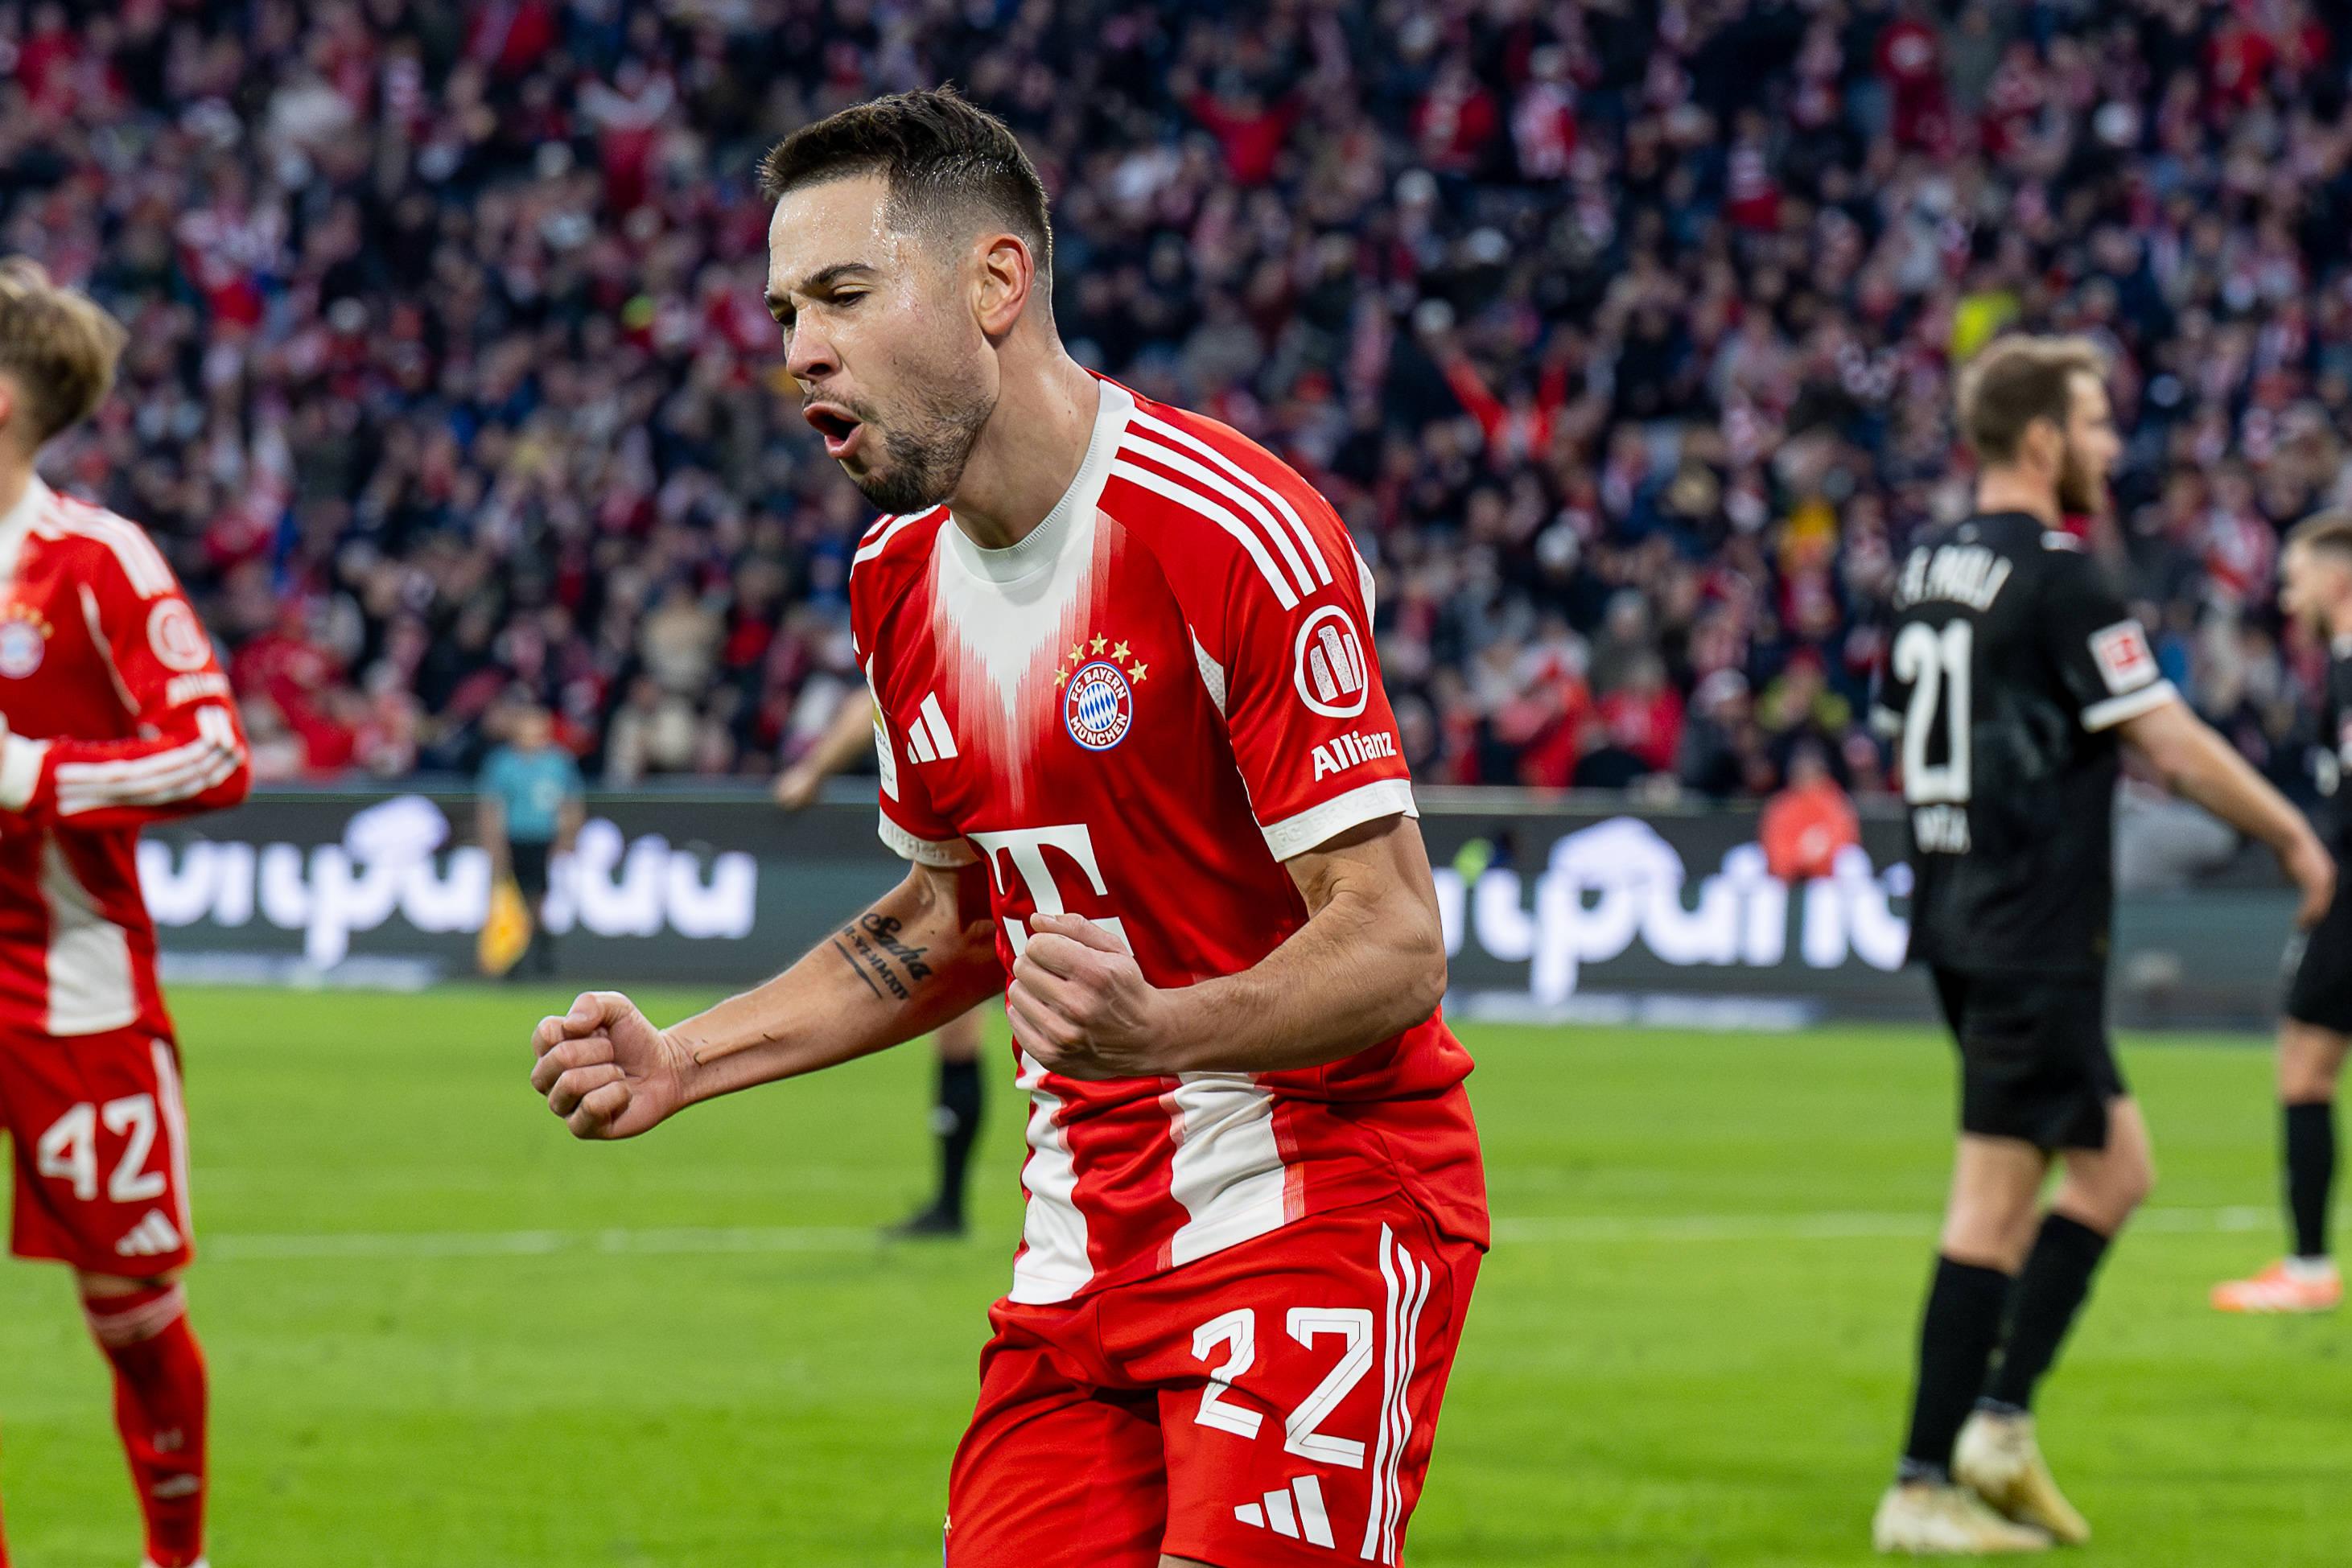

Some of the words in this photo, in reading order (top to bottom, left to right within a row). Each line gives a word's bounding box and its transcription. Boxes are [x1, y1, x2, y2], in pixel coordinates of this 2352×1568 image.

[1070, 681, 1084, 702] FC
[1083, 668, 1127, 700] BAYERN
[1893, 618, 1972, 804] 21
[1311, 730, 1397, 782] Allianz
[36, 1092, 167, 1204] 42
[1191, 1307, 1374, 1470] 22
